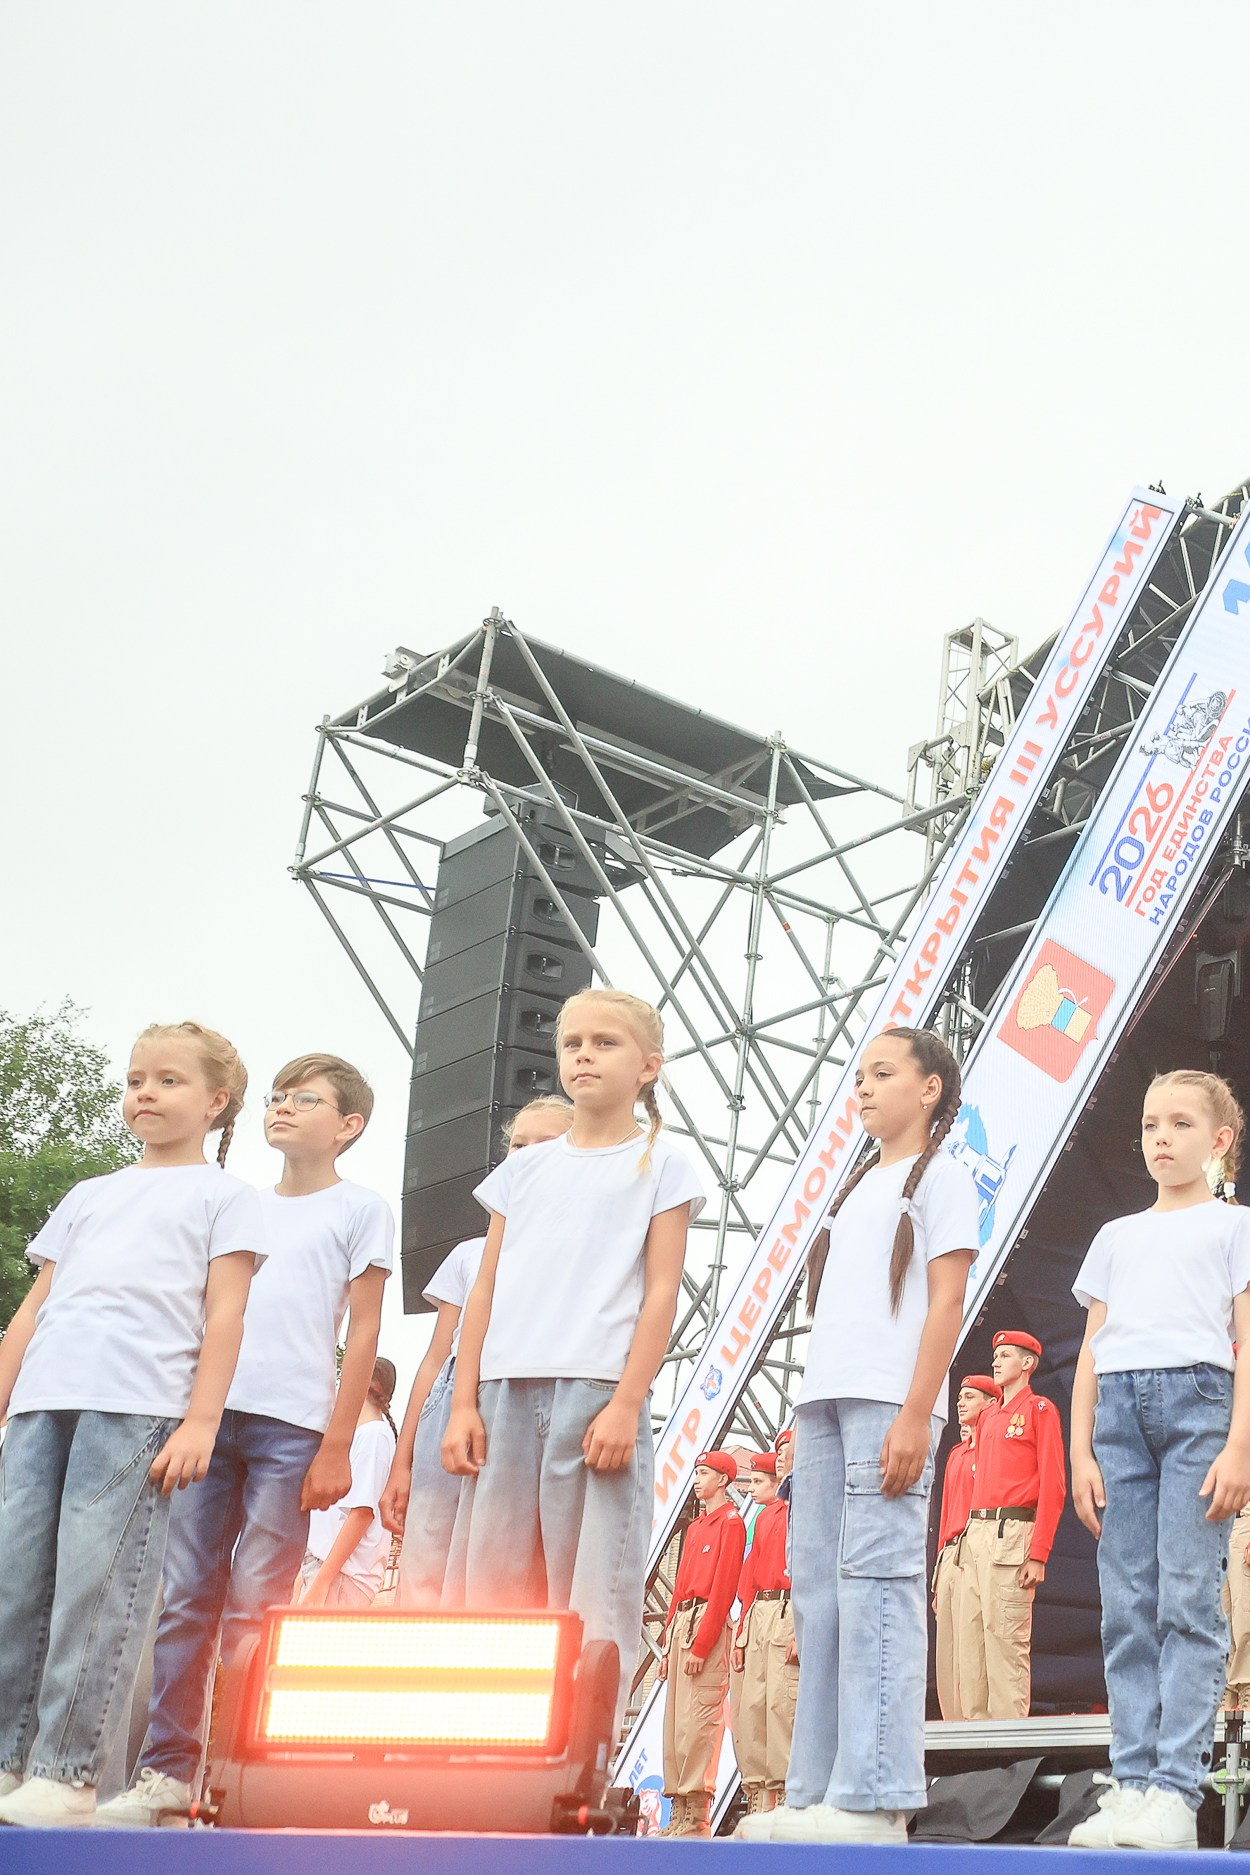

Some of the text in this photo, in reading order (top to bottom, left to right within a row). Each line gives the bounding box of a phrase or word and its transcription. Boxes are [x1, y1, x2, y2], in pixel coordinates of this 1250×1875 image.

[1099, 782, 1174, 903] 2026
[1134, 735, 1234, 917] ГОД ЕДИНСТВА
[1149, 810, 1214, 925] НАРОДОВ
[654, 1407, 701, 1505] ИГР
[720, 1096, 860, 1368] ЦЕРЕМОНИ
[881, 796, 1016, 1033] ТКРЫТИЯ
[1008, 740, 1044, 787] III
